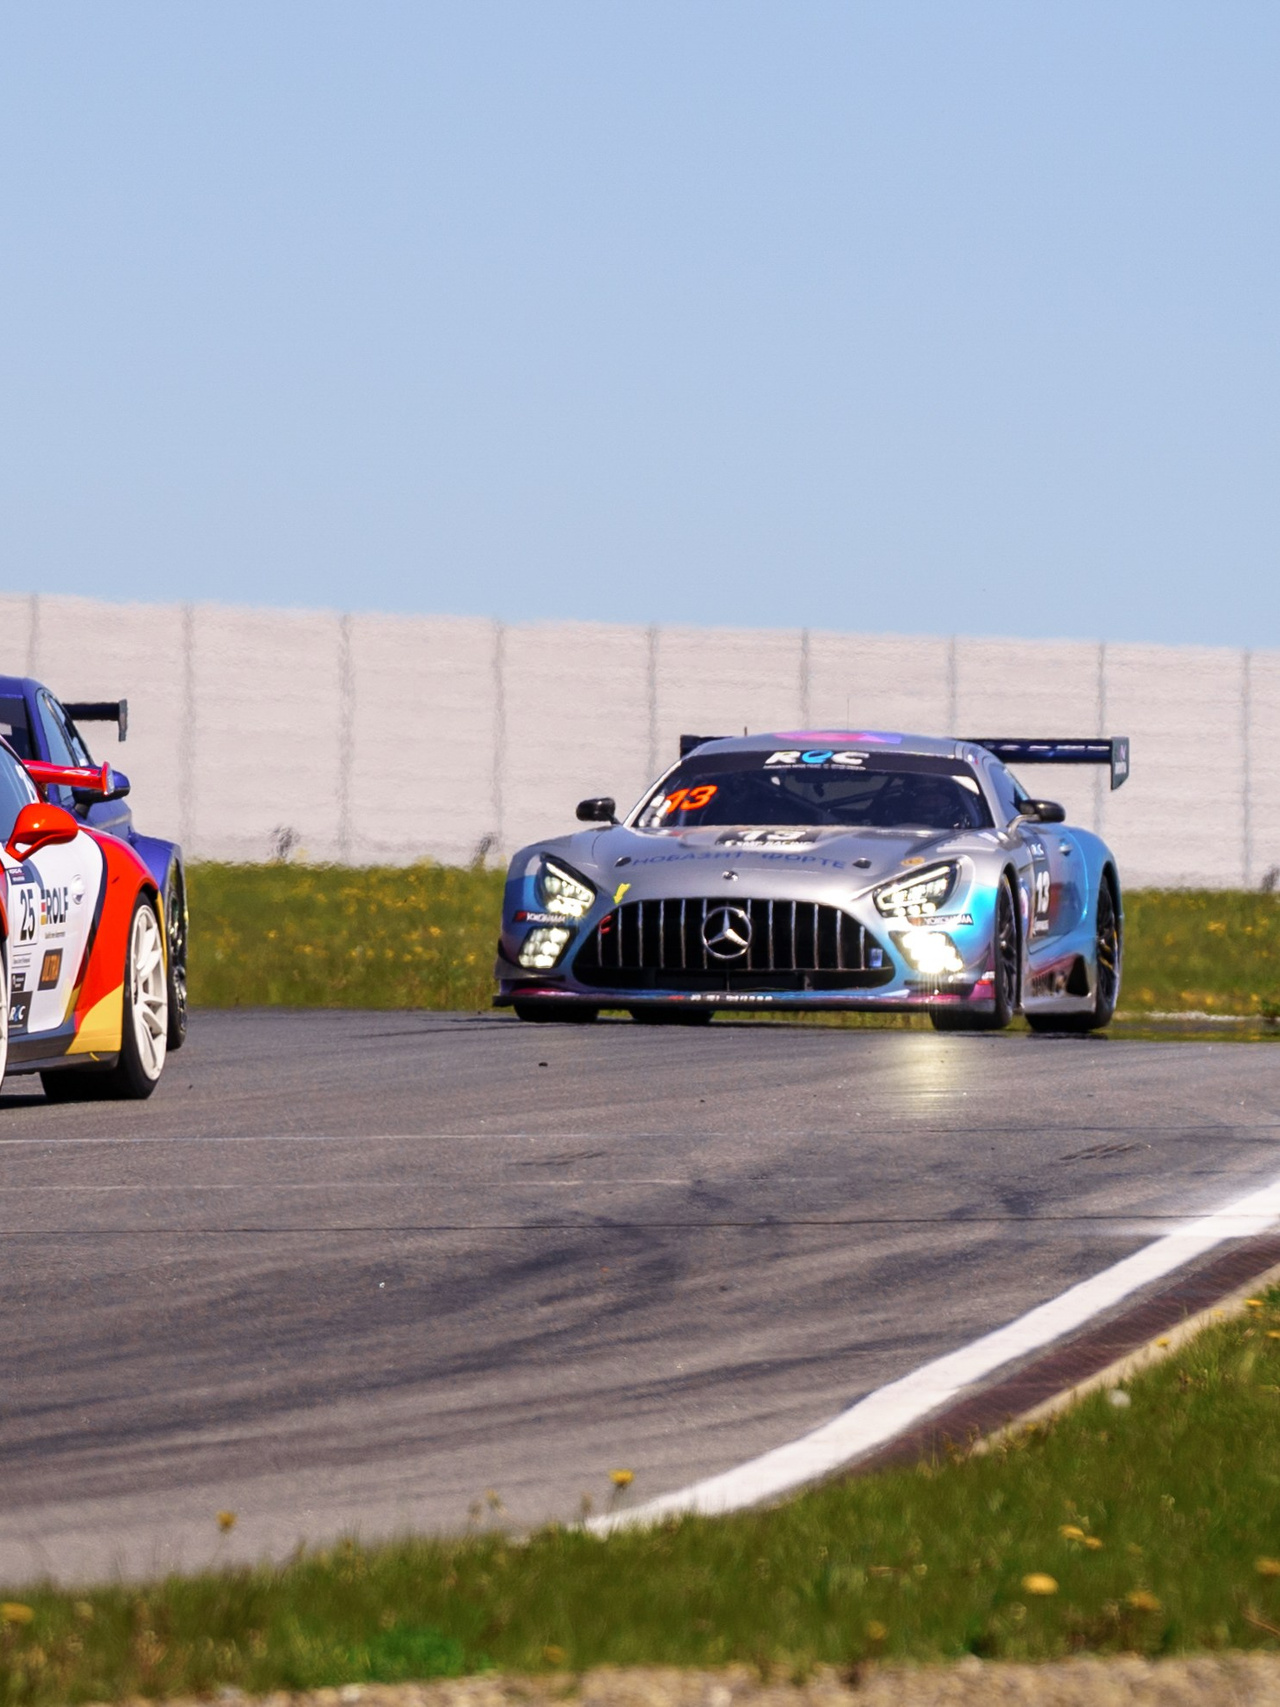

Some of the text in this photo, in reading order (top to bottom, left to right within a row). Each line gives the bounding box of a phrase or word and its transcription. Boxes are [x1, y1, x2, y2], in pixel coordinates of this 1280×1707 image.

[665, 784, 718, 813] 13
[761, 852, 847, 870] ФОРТЕ
[20, 889, 36, 941] 25
[46, 887, 68, 924] ROLF
